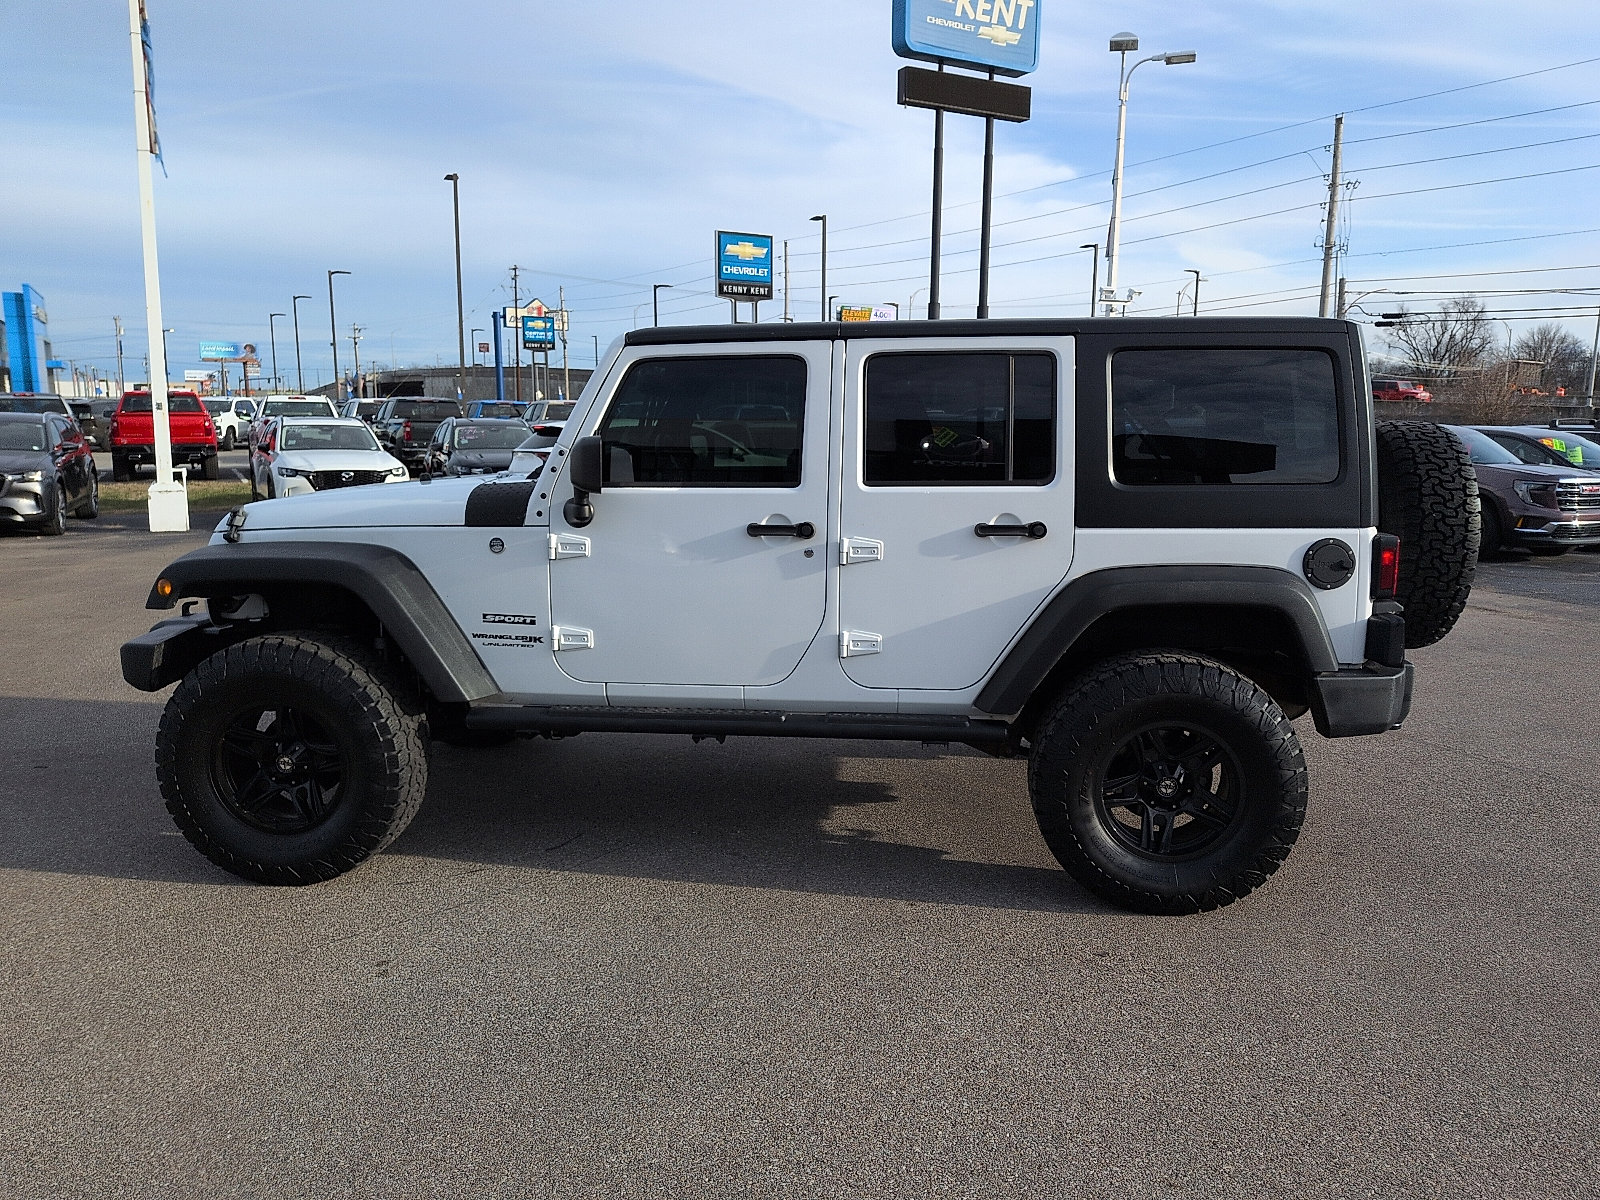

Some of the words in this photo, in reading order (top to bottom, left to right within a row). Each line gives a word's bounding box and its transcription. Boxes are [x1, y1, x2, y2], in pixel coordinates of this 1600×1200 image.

[955, 0, 1034, 30] KENT
[927, 15, 975, 32] CHEVROLET
[722, 265, 769, 277] CHEVROLET
[723, 284, 748, 295] KENNY
[750, 285, 769, 296] KENT
[842, 309, 870, 318] ELEVATE
[485, 614, 534, 624] SPORT
